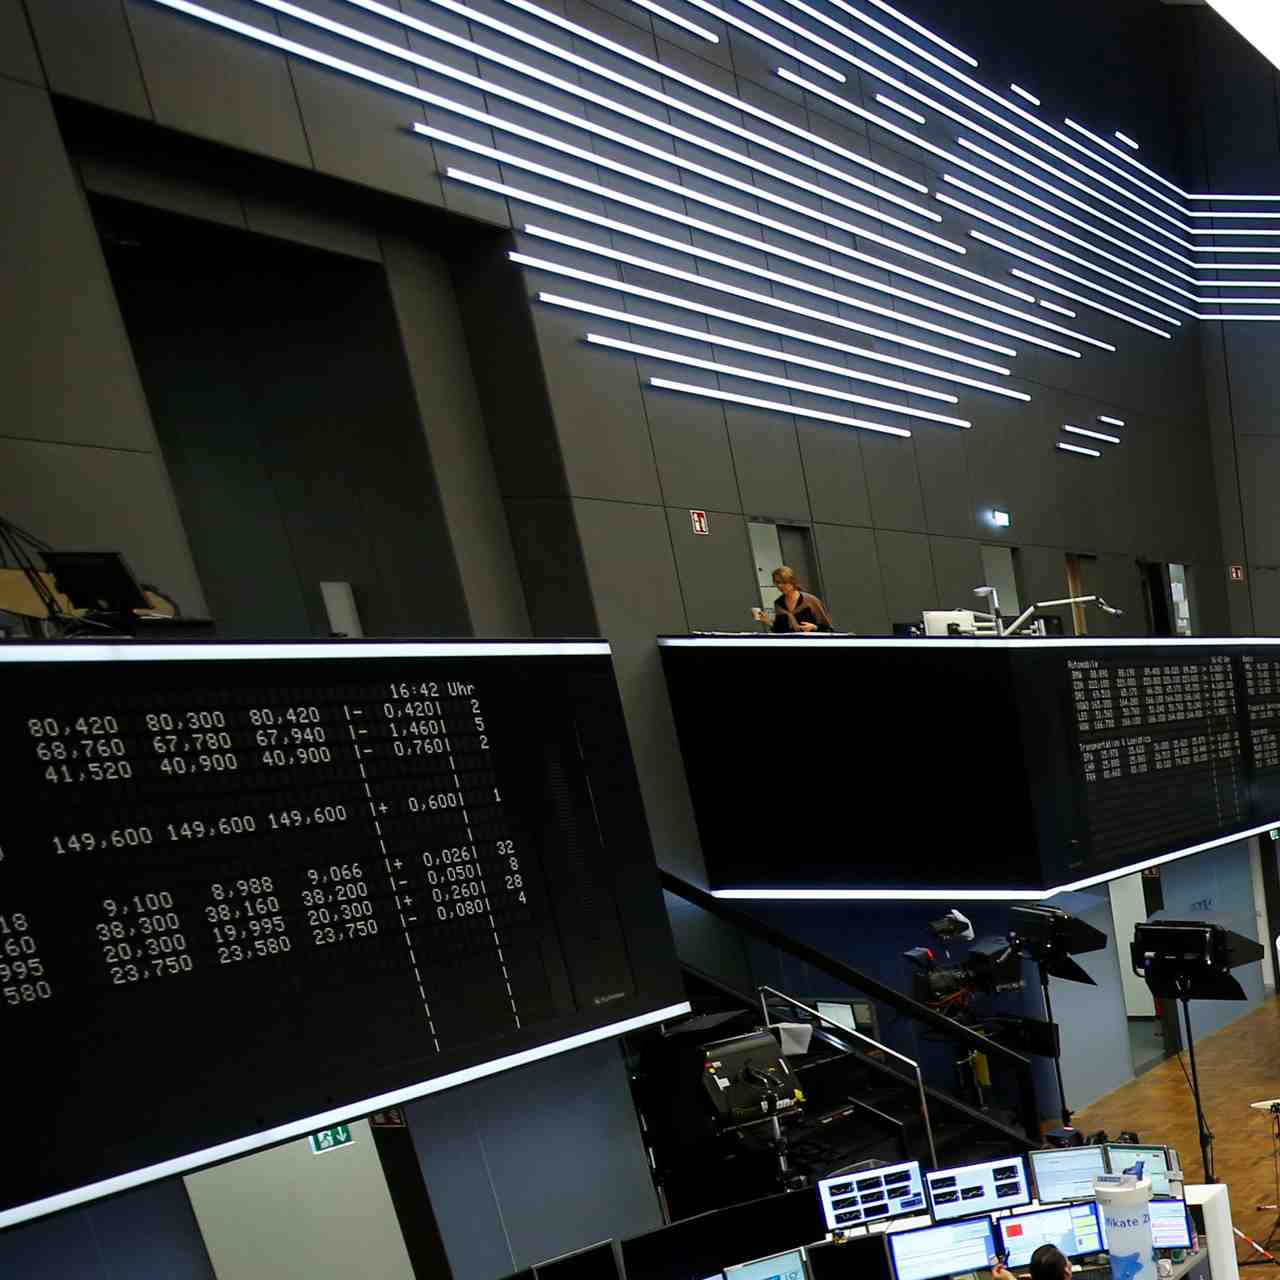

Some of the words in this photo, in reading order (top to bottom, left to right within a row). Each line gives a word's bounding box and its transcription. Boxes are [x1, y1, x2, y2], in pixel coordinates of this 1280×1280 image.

[28, 716, 118, 737] 80,420
[146, 711, 225, 731] 80,300
[249, 707, 320, 725] 80,420
[471, 699, 480, 713] 2
[390, 682, 439, 698] 16:42
[447, 682, 474, 696] Uhr
[37, 739, 125, 760] 68,760
[153, 732, 232, 753] 67,780
[256, 727, 325, 746] 67,940
[474, 717, 485, 731] 5
[46, 761, 132, 783] 41,520
[161, 753, 237, 774] 40,900
[262, 747, 330, 766] 40,900
[480, 735, 489, 749] 2
[53, 827, 152, 854] 149,600
[168, 816, 255, 840] 149,600
[268, 805, 346, 828] 149,600
[494, 788, 501, 802] 1
[96, 913, 179, 941] 38,300
[205, 896, 280, 922] 38,160
[302, 882, 367, 906] 38,200
[509, 857, 519, 870] 8
[104, 892, 173, 917] 9,100
[211, 876, 273, 900] 8,988
[307, 863, 362, 885] 9,066
[496, 840, 515, 855] 32
[103, 934, 186, 963] 20,300
[213, 916, 285, 943] 19,995
[307, 901, 373, 926] 20,300
[505, 874, 522, 889] 28
[110, 955, 192, 984] 23,750
[218, 936, 291, 964] 23,580
[313, 919, 378, 945] 23,750
[518, 891, 526, 904] 4
